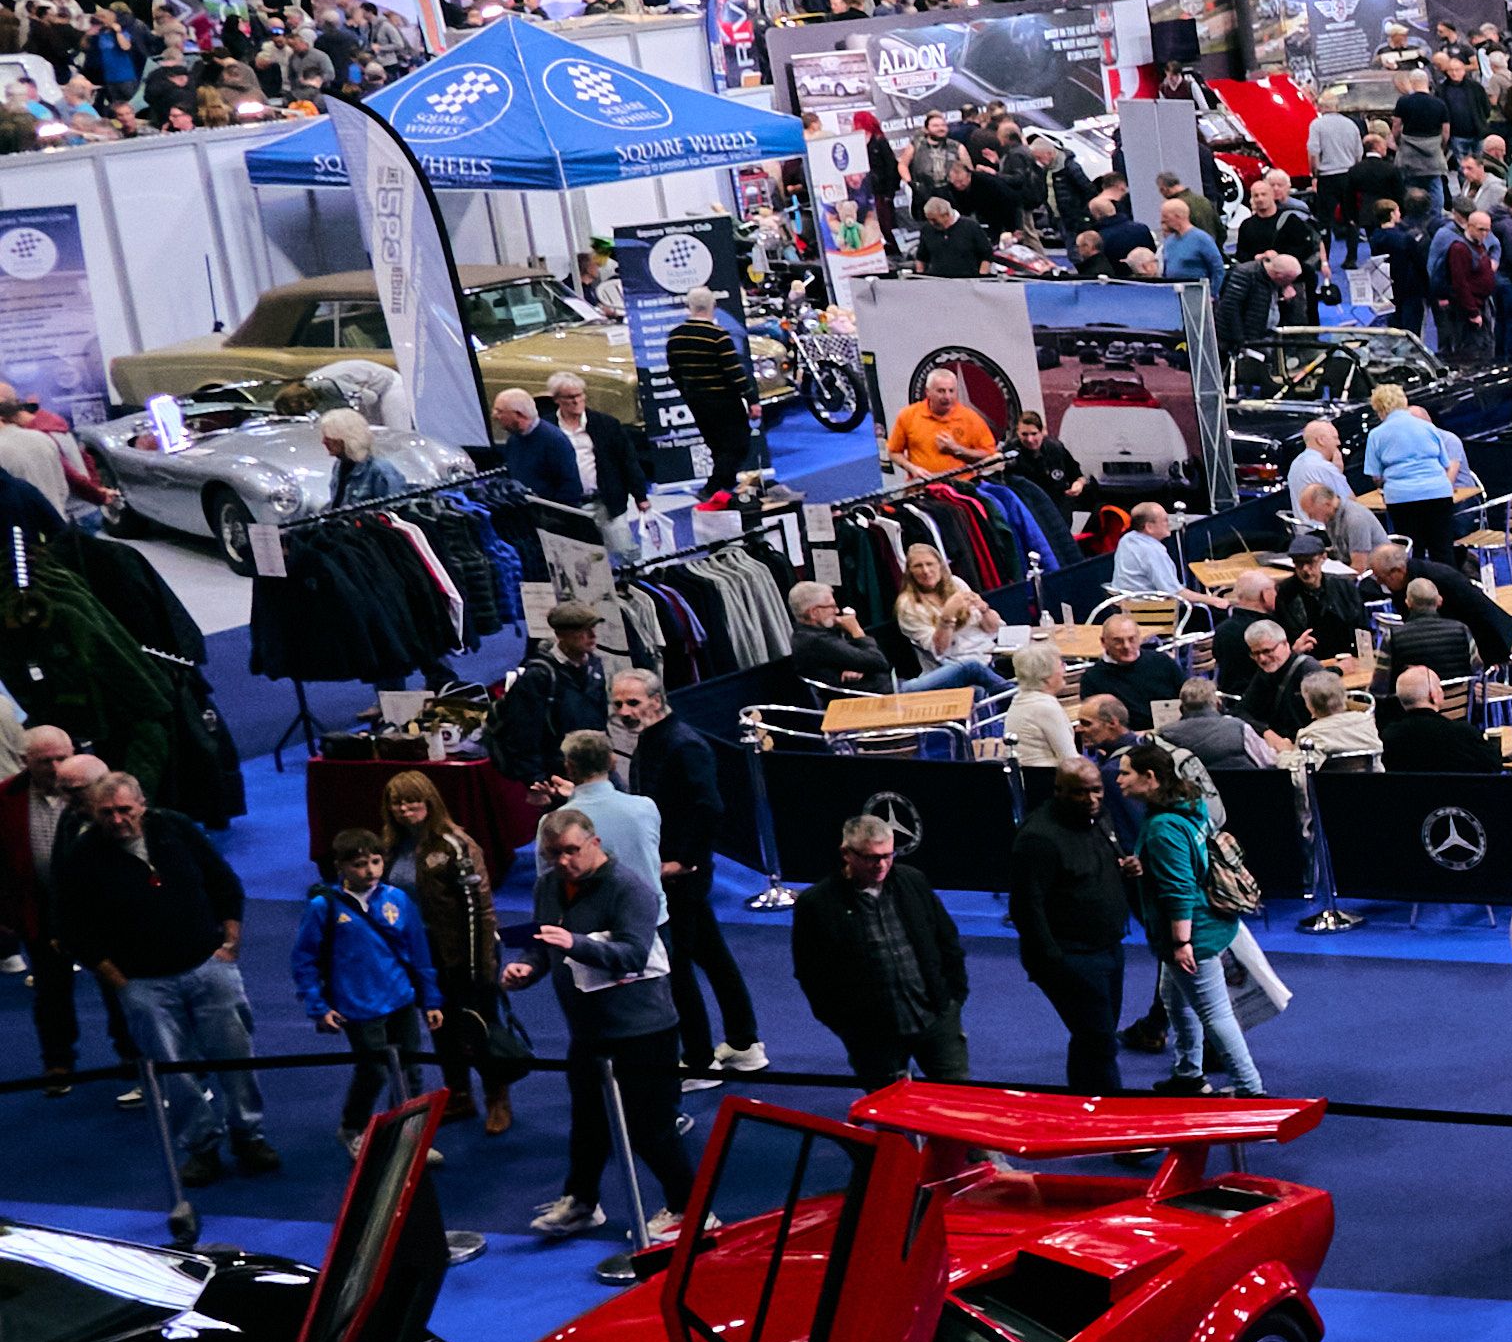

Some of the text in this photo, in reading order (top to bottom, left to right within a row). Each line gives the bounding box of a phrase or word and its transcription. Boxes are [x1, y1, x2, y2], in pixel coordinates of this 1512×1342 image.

[878, 42, 947, 76] ALDON
[614, 131, 758, 164] SQUARE WHEELS
[691, 223, 712, 234] Club
